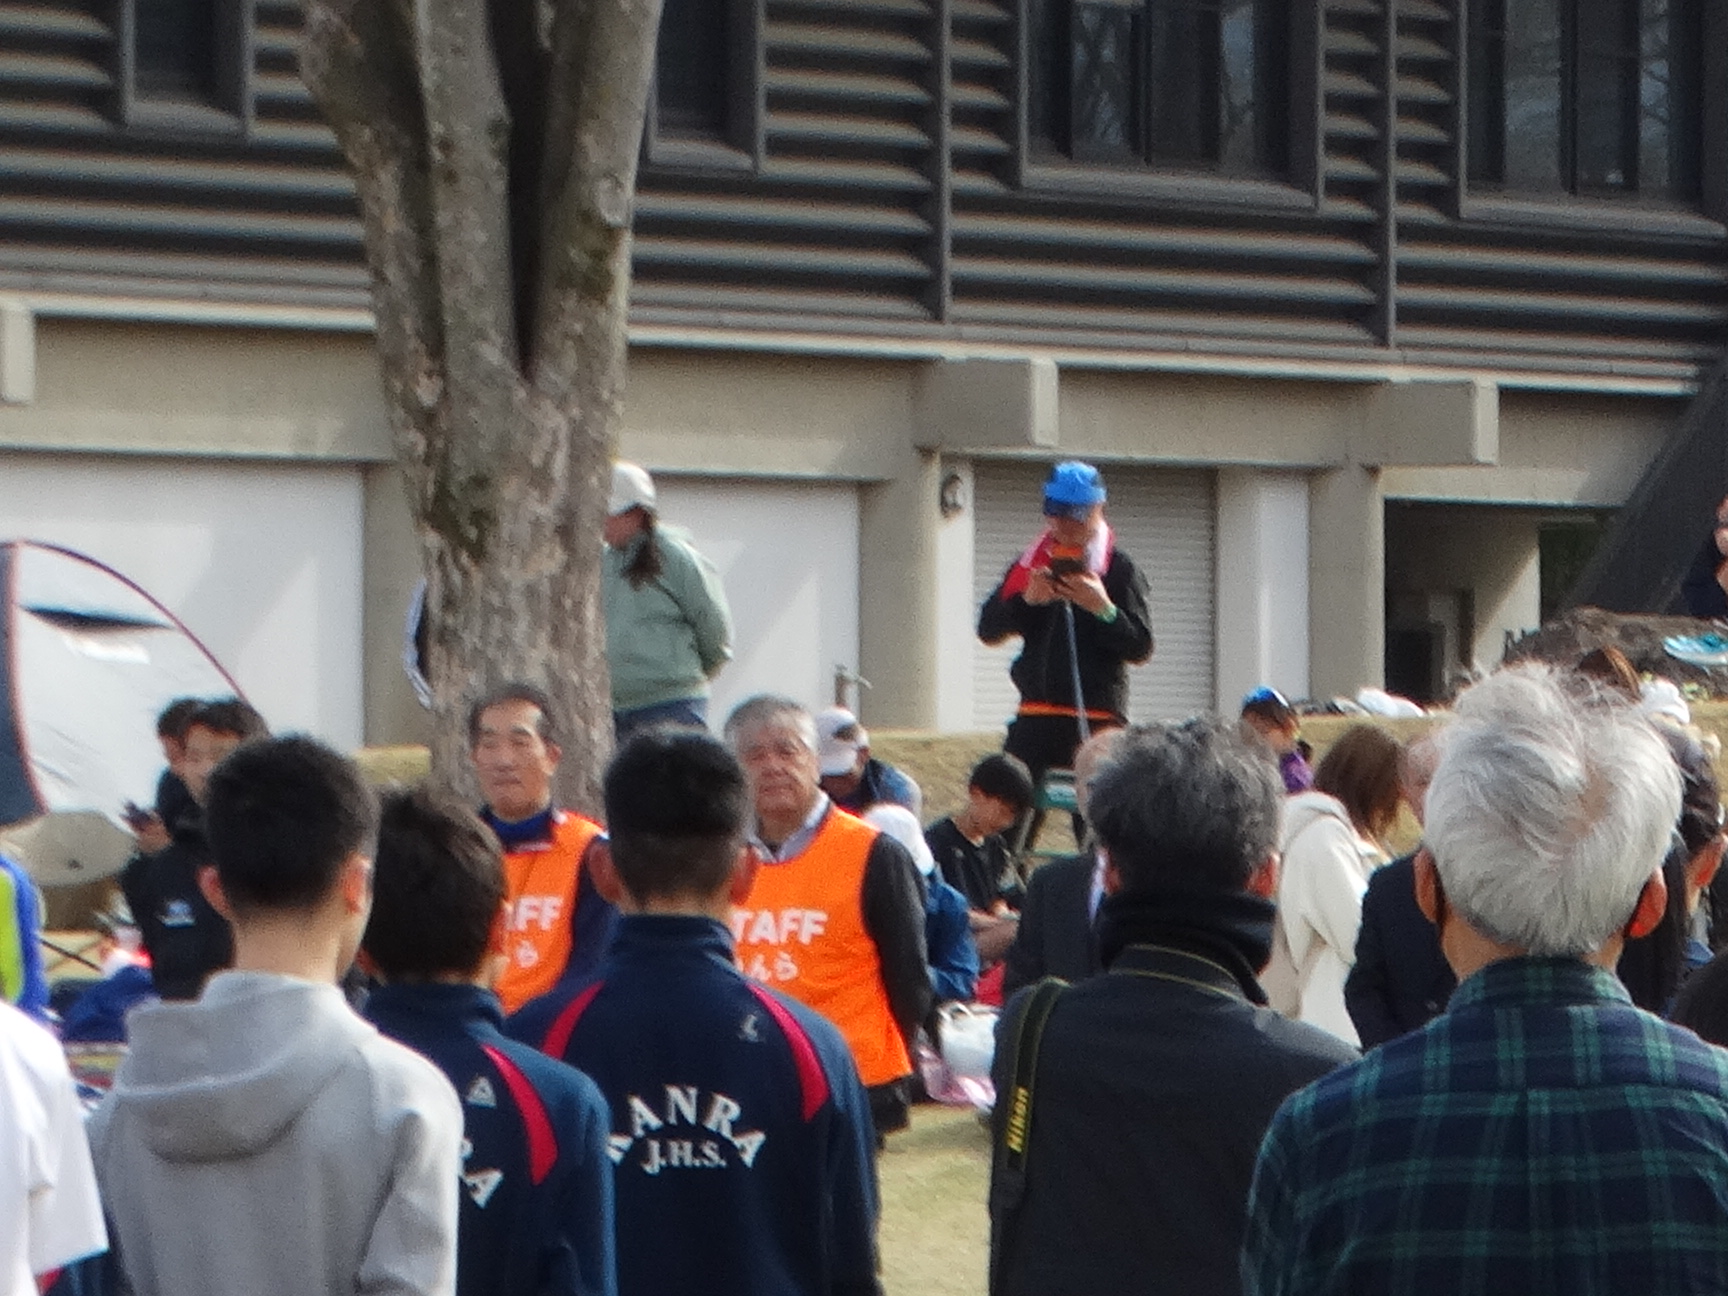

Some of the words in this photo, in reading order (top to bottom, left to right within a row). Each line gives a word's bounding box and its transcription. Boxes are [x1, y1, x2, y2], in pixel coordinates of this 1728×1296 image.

[731, 907, 829, 945] TAFF
[1006, 1086, 1030, 1153] Nikon
[641, 1139, 727, 1175] J.H.S.
